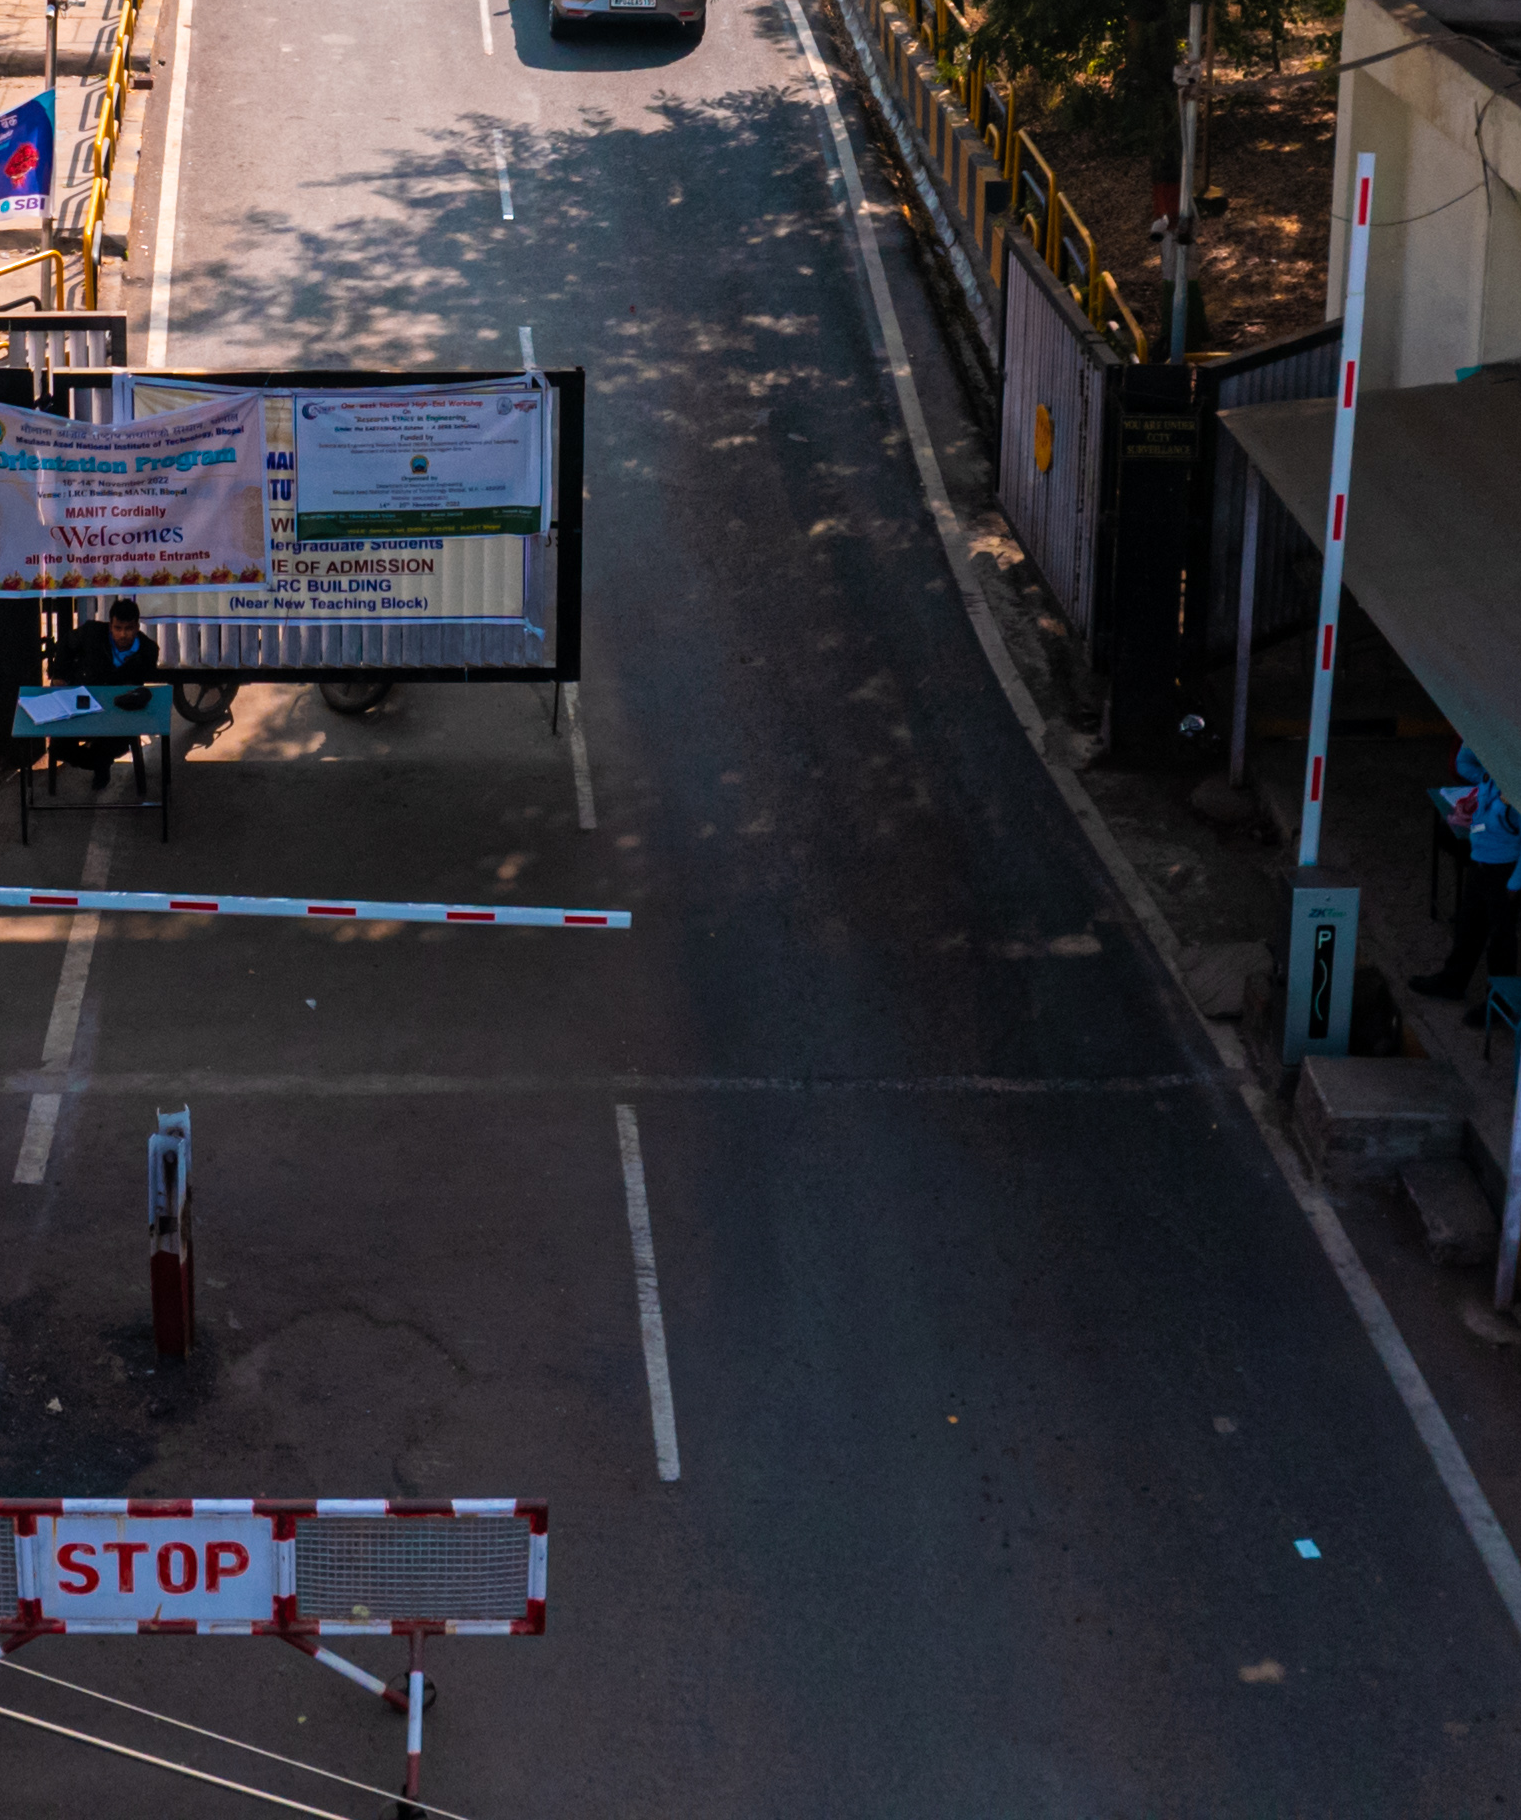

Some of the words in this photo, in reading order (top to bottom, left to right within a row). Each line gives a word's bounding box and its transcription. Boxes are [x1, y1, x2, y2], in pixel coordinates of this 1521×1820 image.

[14, 196, 45, 211] SBI
[1143, 419, 1163, 430] ARE
[1164, 419, 1196, 430] UNDER
[76, 442, 112, 452] National
[114, 441, 151, 451] Institute
[153, 439, 163, 449] of
[134, 446, 237, 473] Program
[64, 506, 107, 519] MANIT
[111, 505, 167, 519] Cordially
[50, 524, 184, 549] Welcomes
[25, 552, 40, 565] all
[43, 552, 63, 564] the
[66, 550, 156, 566] Undergraduate
[159, 549, 211, 561] Entrants
[294, 560, 321, 574] OF
[326, 558, 435, 574] ADMISSION
[308, 579, 392, 593] BUILDING
[229, 595, 269, 612] (Near
[273, 597, 305, 610] New
[310, 596, 377, 612] Teaching
[381, 595, 429, 612] Block)
[1317, 930, 1333, 949] P
[55, 1539, 251, 1595] STOP
